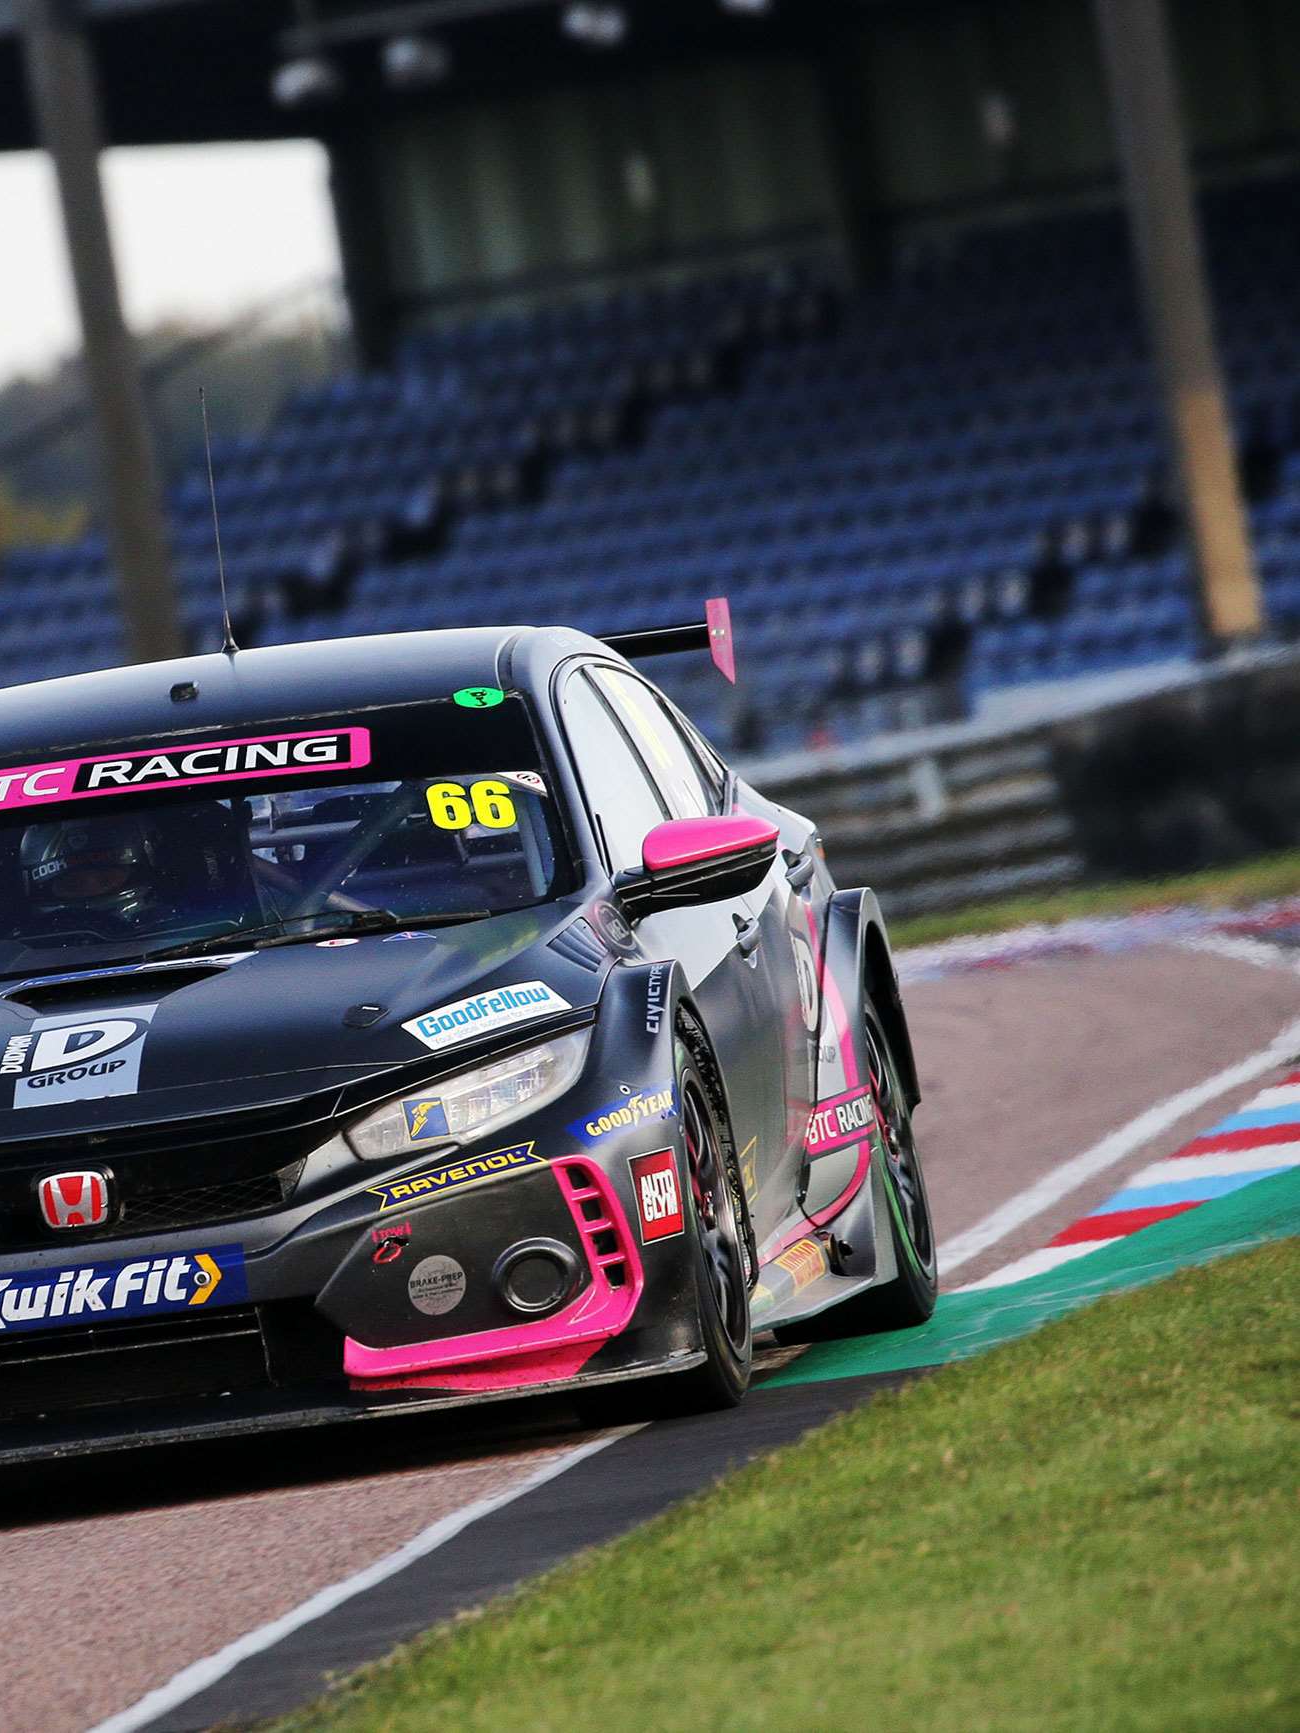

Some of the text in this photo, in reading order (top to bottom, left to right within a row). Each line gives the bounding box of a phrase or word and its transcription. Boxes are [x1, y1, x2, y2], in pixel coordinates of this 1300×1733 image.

[87, 737, 337, 788] RACING
[426, 780, 517, 830] 66
[0, 1034, 34, 1075] DUDMAN
[27, 1060, 126, 1089] GROUP
[586, 1090, 674, 1137] GOODYEAR
[807, 1107, 837, 1146] BTC
[390, 1150, 527, 1199] RAVENOL
[640, 1169, 676, 1199] AUTO
[643, 1193, 678, 1222] GLYM
[410, 1271, 463, 1289] BRAKE-PREP
